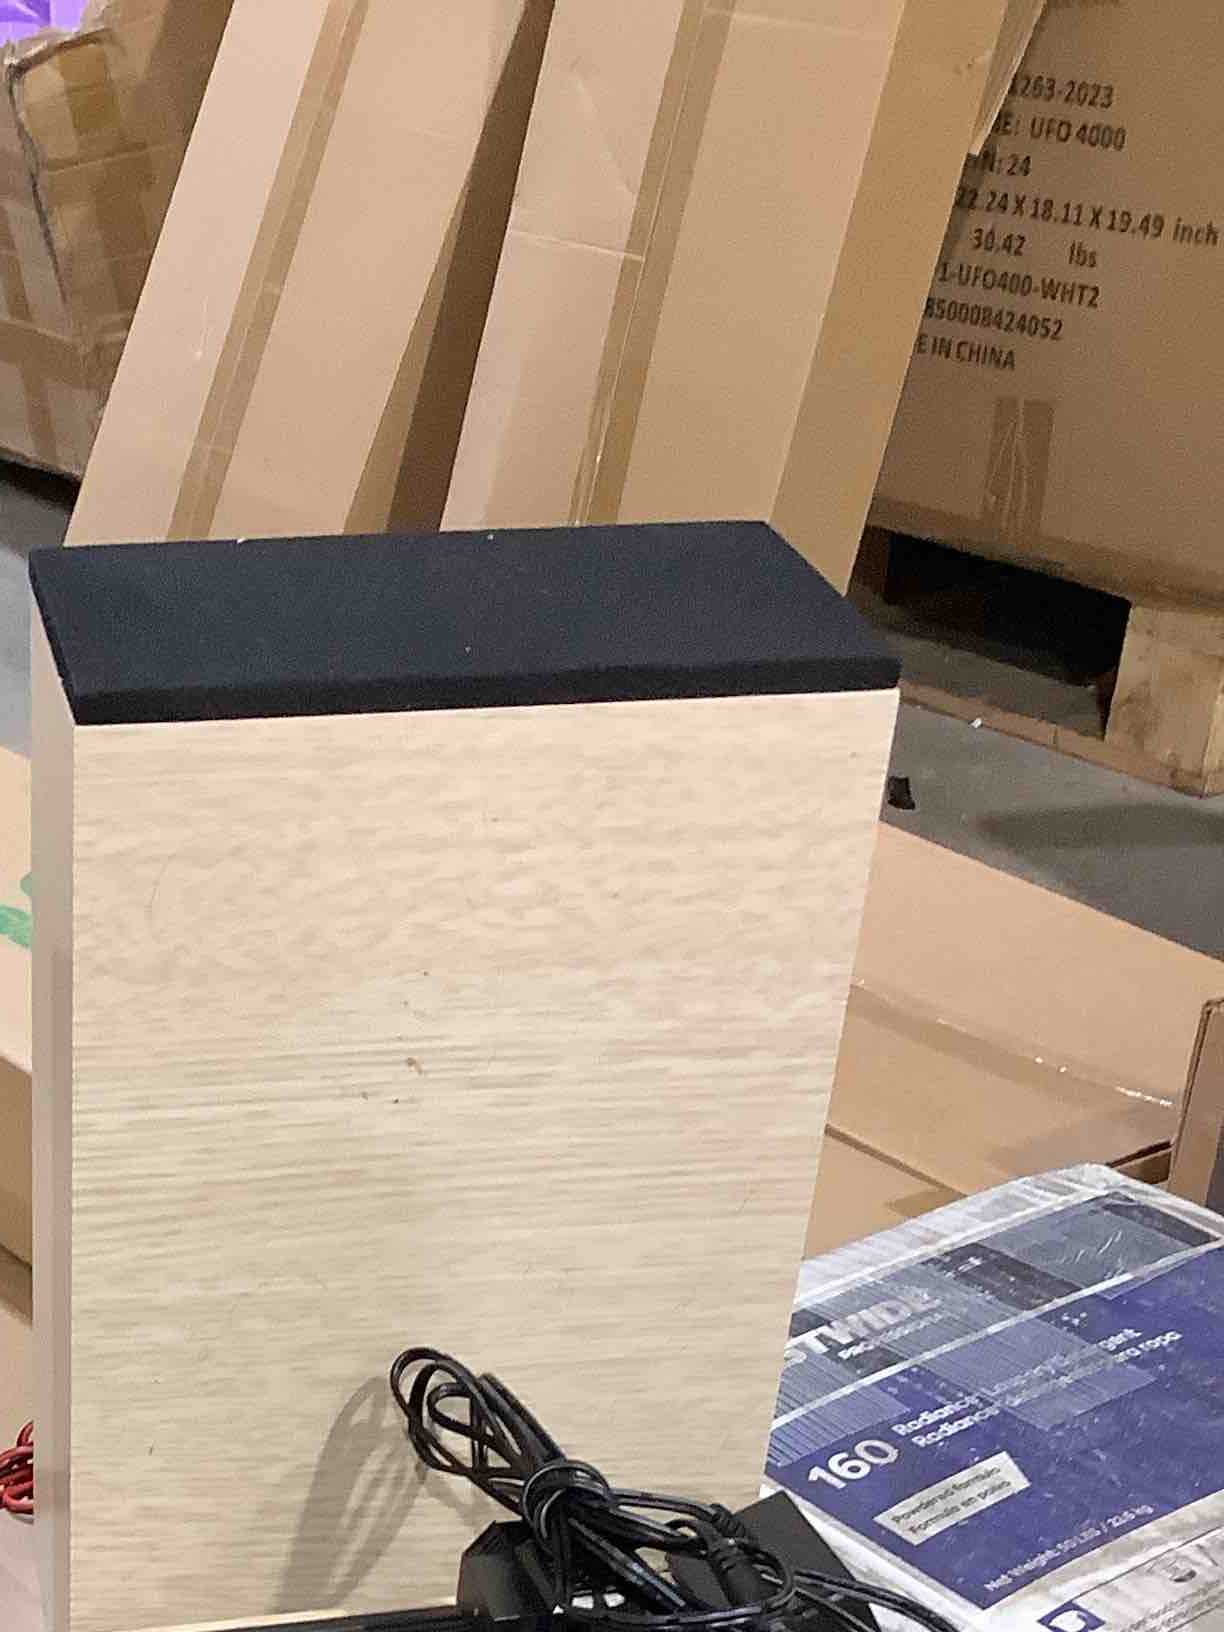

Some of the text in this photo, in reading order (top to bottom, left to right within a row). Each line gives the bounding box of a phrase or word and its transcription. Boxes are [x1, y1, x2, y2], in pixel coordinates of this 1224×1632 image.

[1030, 116, 1073, 144] UFO
[1076, 122, 1127, 151] 4000
[1006, 155, 1032, 177] 24
[1030, 198, 1084, 230] 18.11
[1108, 211, 1165, 240] 19.49
[1172, 217, 1218, 247] inch
[931, 336, 952, 360] IN
[955, 340, 1017, 372] CHINA
[807, 1439, 902, 1490] 160
